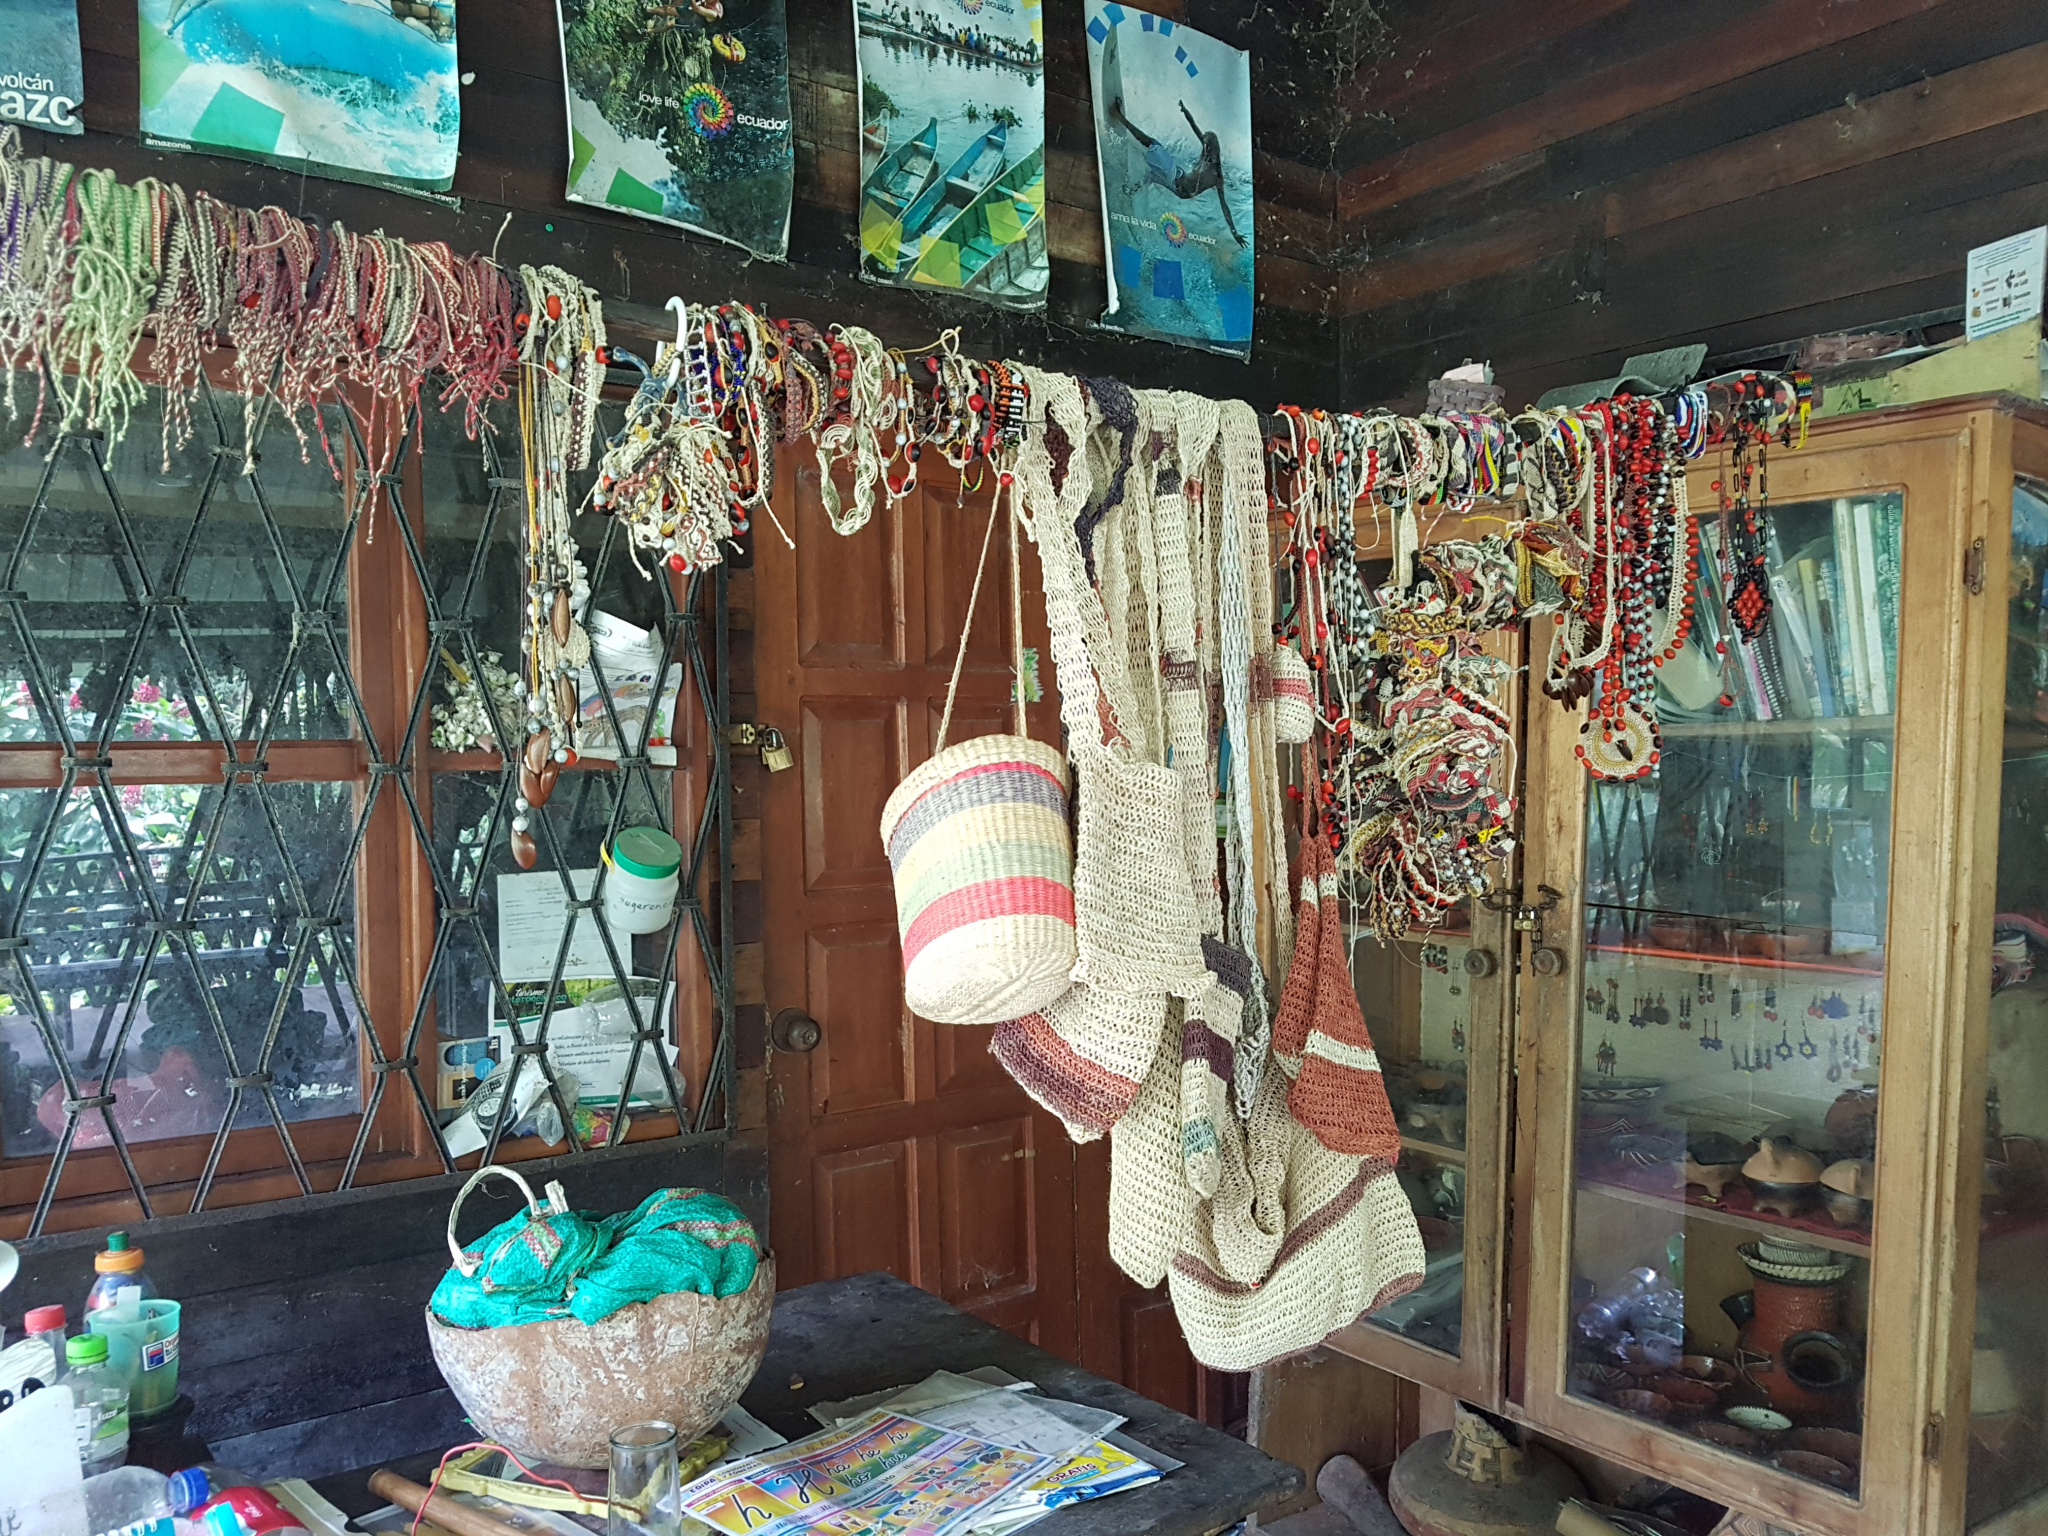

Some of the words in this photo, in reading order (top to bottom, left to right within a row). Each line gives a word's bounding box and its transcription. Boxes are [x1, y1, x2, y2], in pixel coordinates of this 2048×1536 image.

[0, 71, 54, 92] volcán
[640, 91, 662, 105] love
[665, 96, 680, 109] life
[737, 113, 789, 130] ecuador
[145, 138, 191, 150] amazonia
[1140, 219, 1157, 230] vida
[1188, 232, 1217, 245] ecuador
[823, 1461, 851, 1476] ha
[856, 1448, 881, 1462] he
[1046, 1462, 1097, 1483] GRATIS
[690, 1477, 717, 1493] EDIPA
[731, 1493, 773, 1528] h
